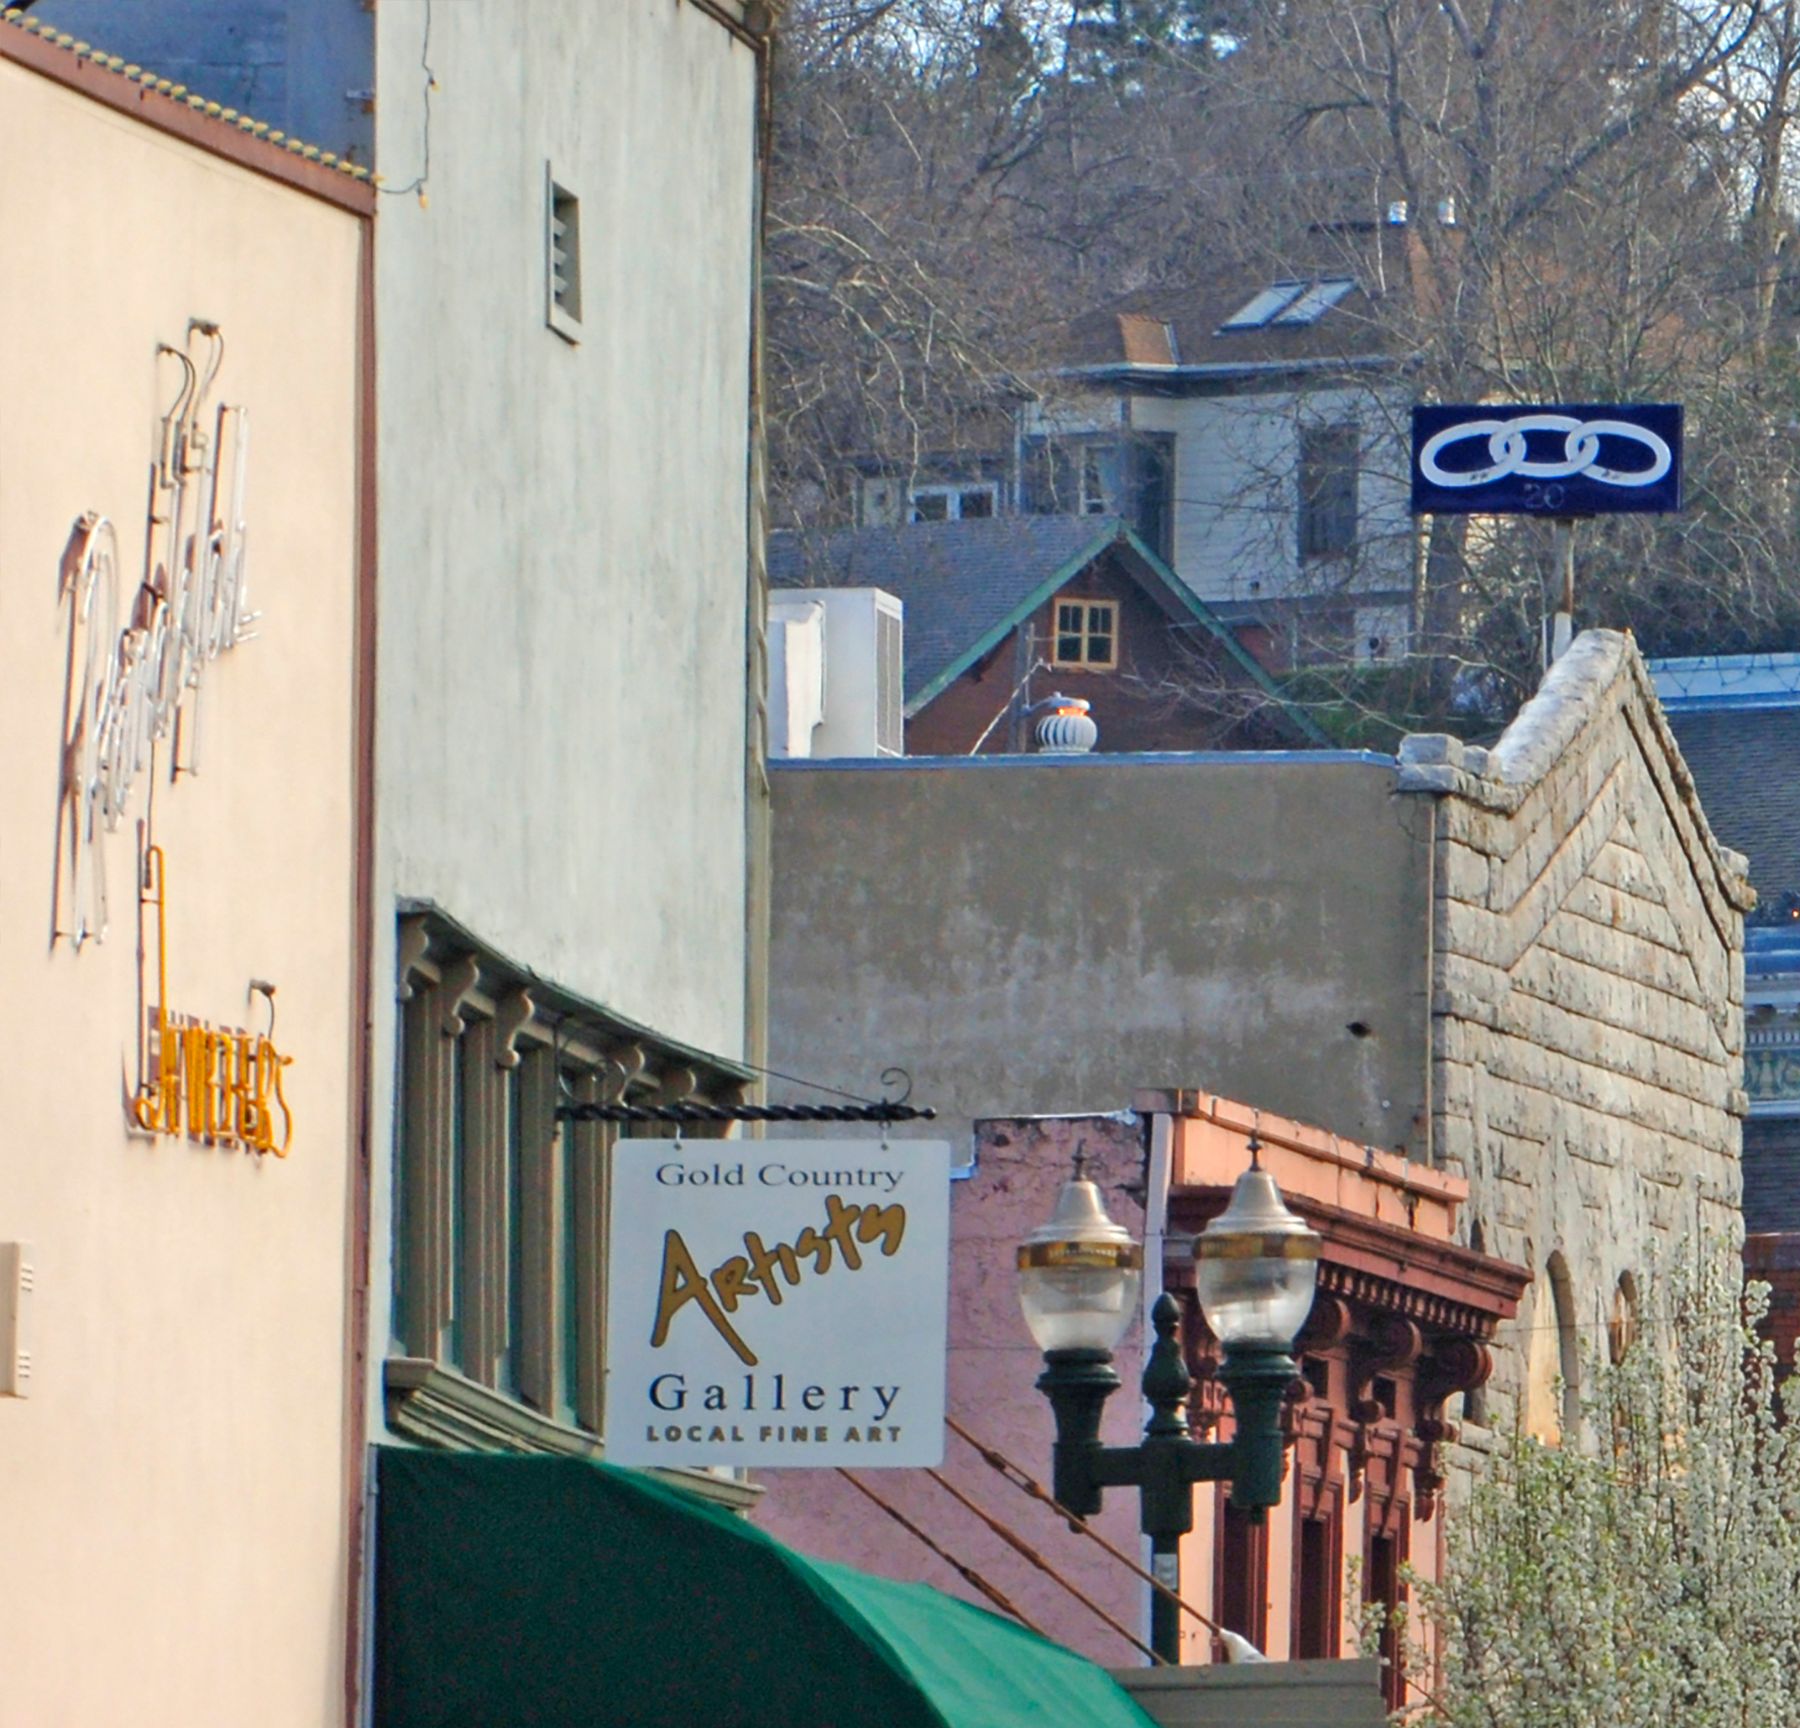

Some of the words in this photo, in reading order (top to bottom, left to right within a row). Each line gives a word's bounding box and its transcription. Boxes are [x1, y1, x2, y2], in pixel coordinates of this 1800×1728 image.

[655, 1163, 745, 1187] Gold
[757, 1163, 905, 1193] Country
[648, 1373, 901, 1422] Gallery
[646, 1424, 745, 1443] LOCAL
[759, 1424, 829, 1443] FINE
[843, 1424, 902, 1443] ART
